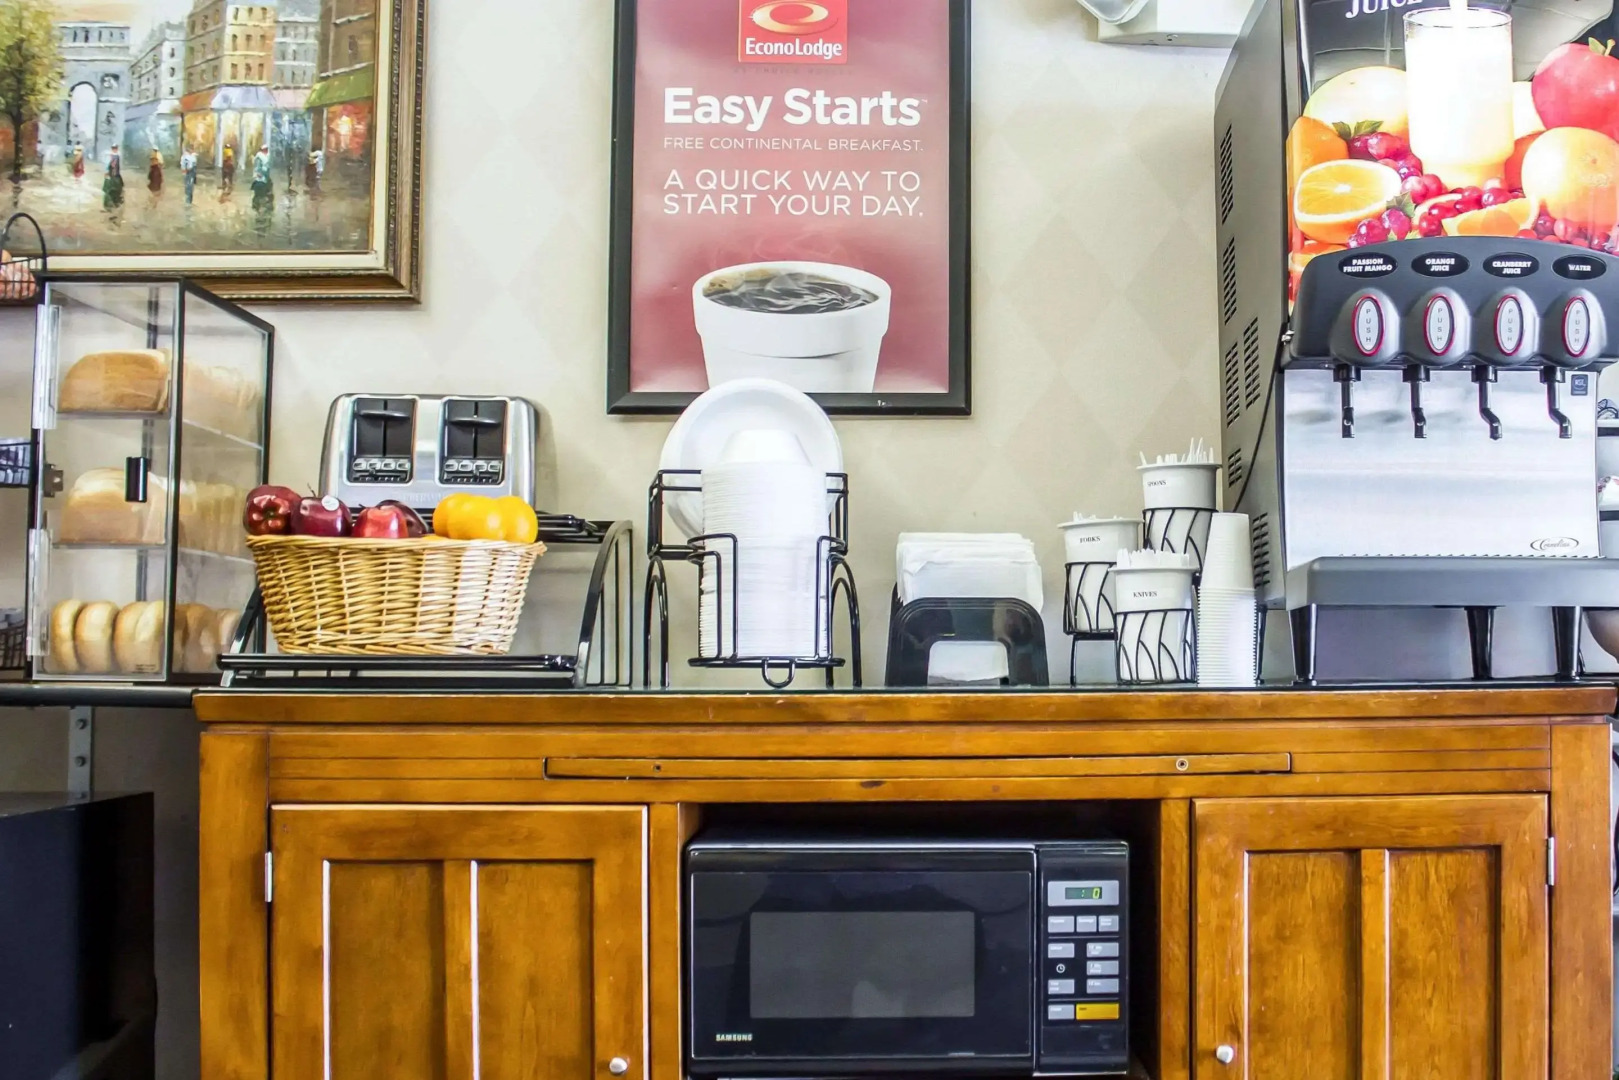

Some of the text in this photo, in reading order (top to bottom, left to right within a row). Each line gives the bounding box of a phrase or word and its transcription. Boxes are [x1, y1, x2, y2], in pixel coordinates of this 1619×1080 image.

[1345, 0, 1423, 18] JUI
[745, 37, 843, 60] EconoLodge
[664, 87, 921, 132] Easy Starts
[663, 136, 924, 152] FREE CONTINENTAL BREAKFAST.
[663, 168, 921, 192] A QUICK WAY TO
[663, 193, 924, 217] START YOUR DAY.
[1343, 264, 1393, 273] FRUIT MANGO
[1352, 258, 1384, 266] PASSION
[1502, 267, 1522, 275] JUICE
[715, 1033, 753, 1042] SAMSUNG
